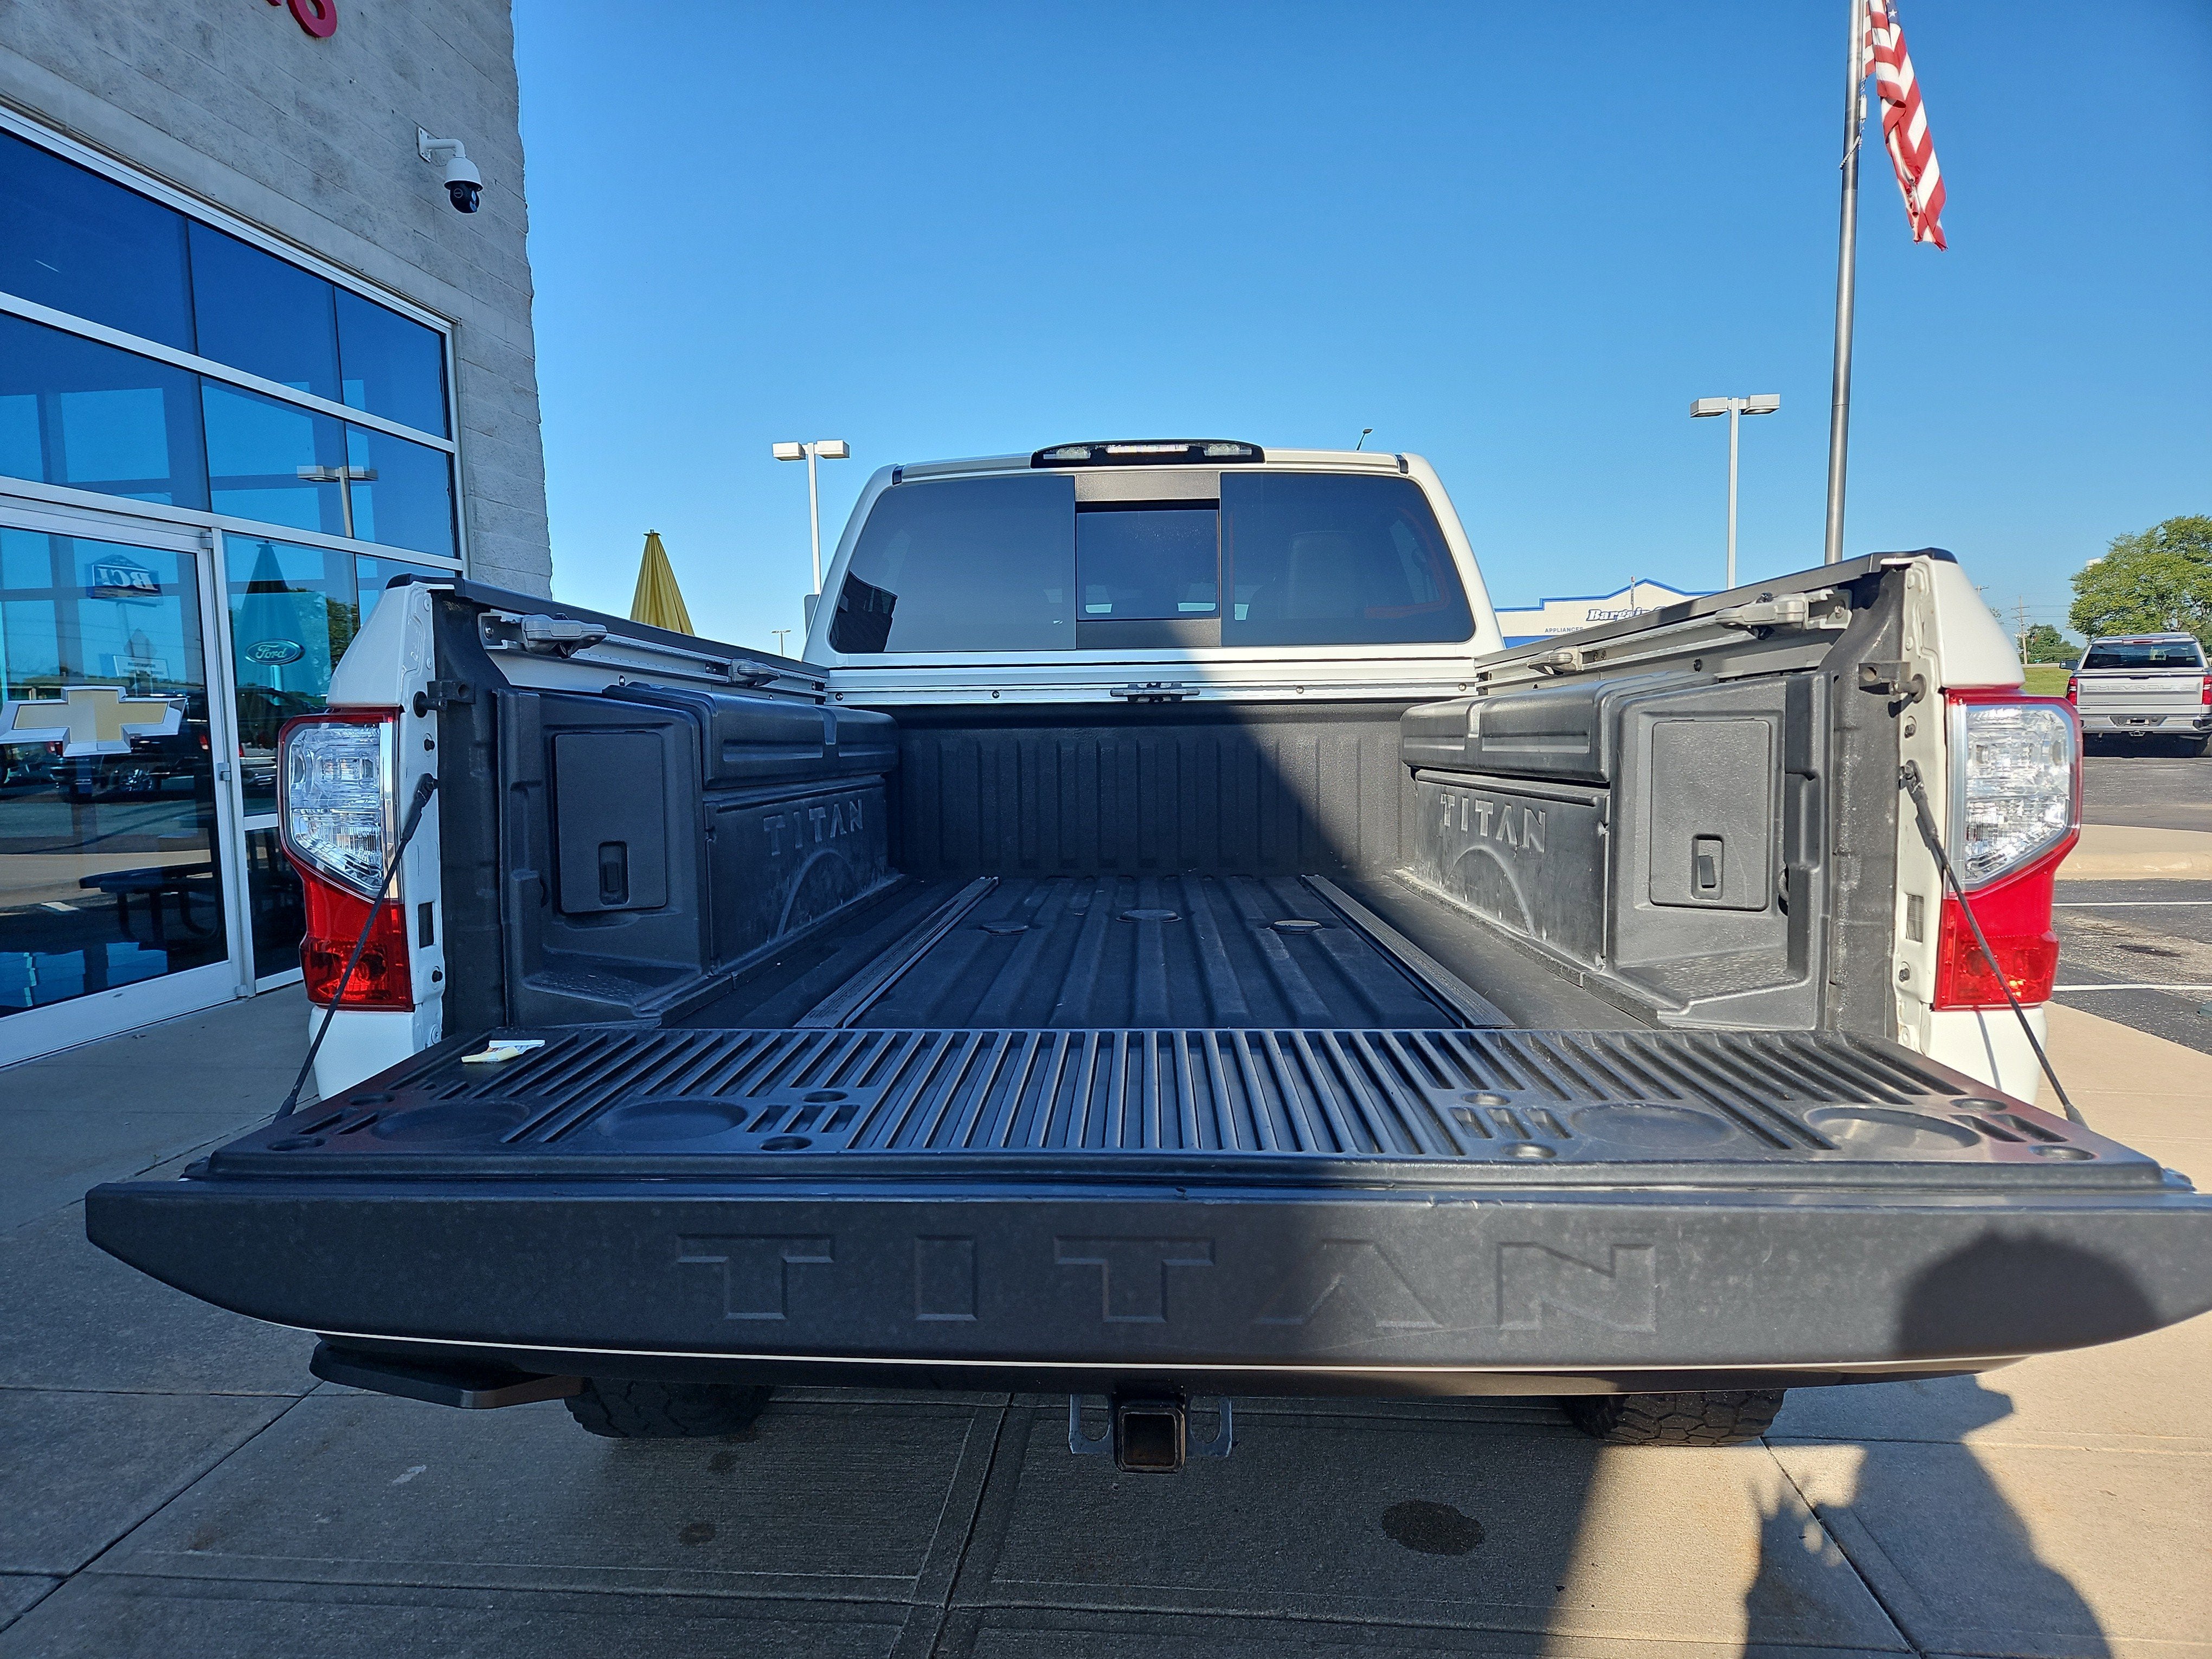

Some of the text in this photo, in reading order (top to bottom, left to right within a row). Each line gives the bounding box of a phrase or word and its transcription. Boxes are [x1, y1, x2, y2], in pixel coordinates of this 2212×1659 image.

[255, 645, 287, 659] Ford
[763, 799, 863, 856] TITAN
[1440, 793, 1546, 853] TITAN
[676, 1233, 1656, 1332] TITAN
